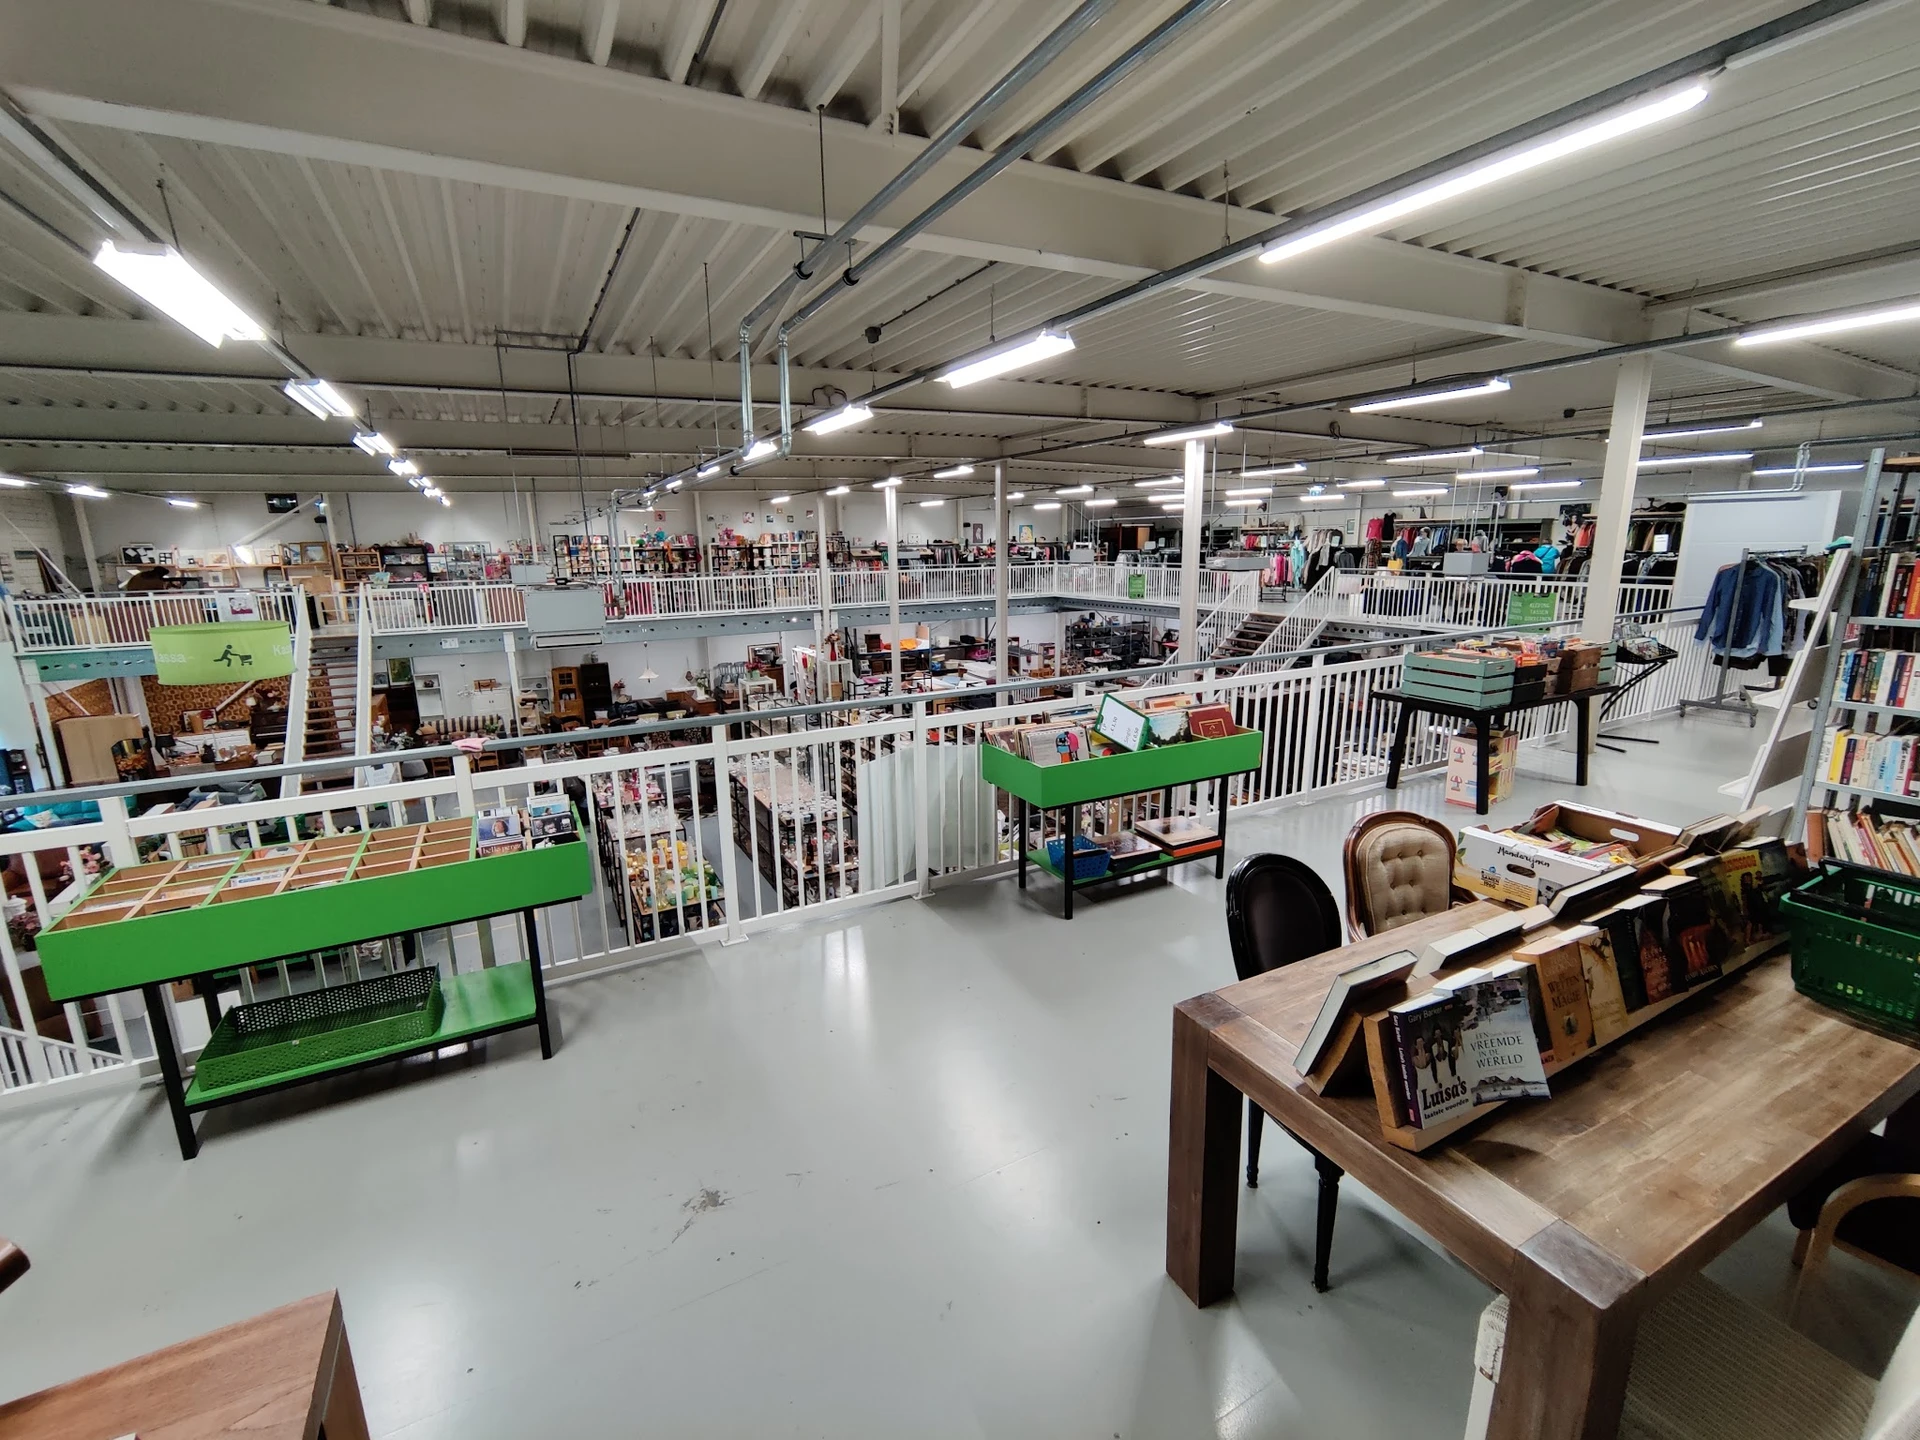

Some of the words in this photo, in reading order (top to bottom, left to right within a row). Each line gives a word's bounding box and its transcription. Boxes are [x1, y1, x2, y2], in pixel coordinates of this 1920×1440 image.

[1407, 1012, 1422, 1024] Gary
[1423, 1006, 1443, 1019] Barker
[1470, 1035, 1524, 1052] VREEMDE
[1476, 1053, 1523, 1069] WERELD
[1478, 1050, 1487, 1058] IN
[1421, 1075, 1467, 1111] Luisa's
[1445, 1098, 1469, 1111] woorden
